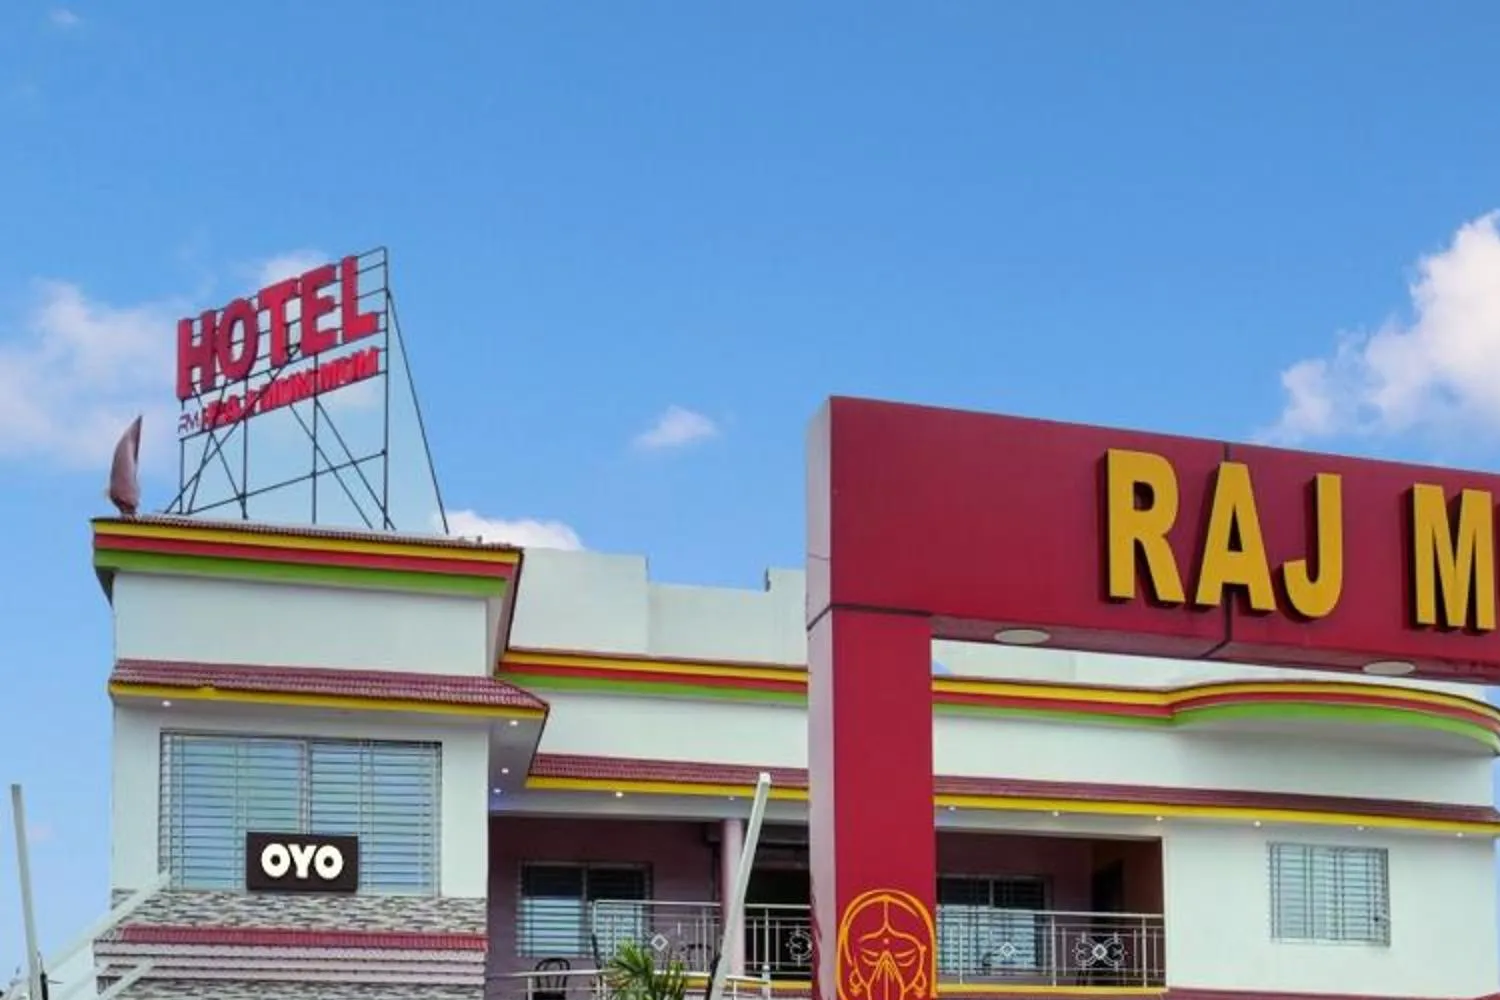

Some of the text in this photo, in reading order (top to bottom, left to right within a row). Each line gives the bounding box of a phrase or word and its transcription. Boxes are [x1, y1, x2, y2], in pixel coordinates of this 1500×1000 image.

[176, 255, 379, 400] HOTEL
[1106, 447, 1343, 619] RAJ
[261, 843, 344, 880] OYO
